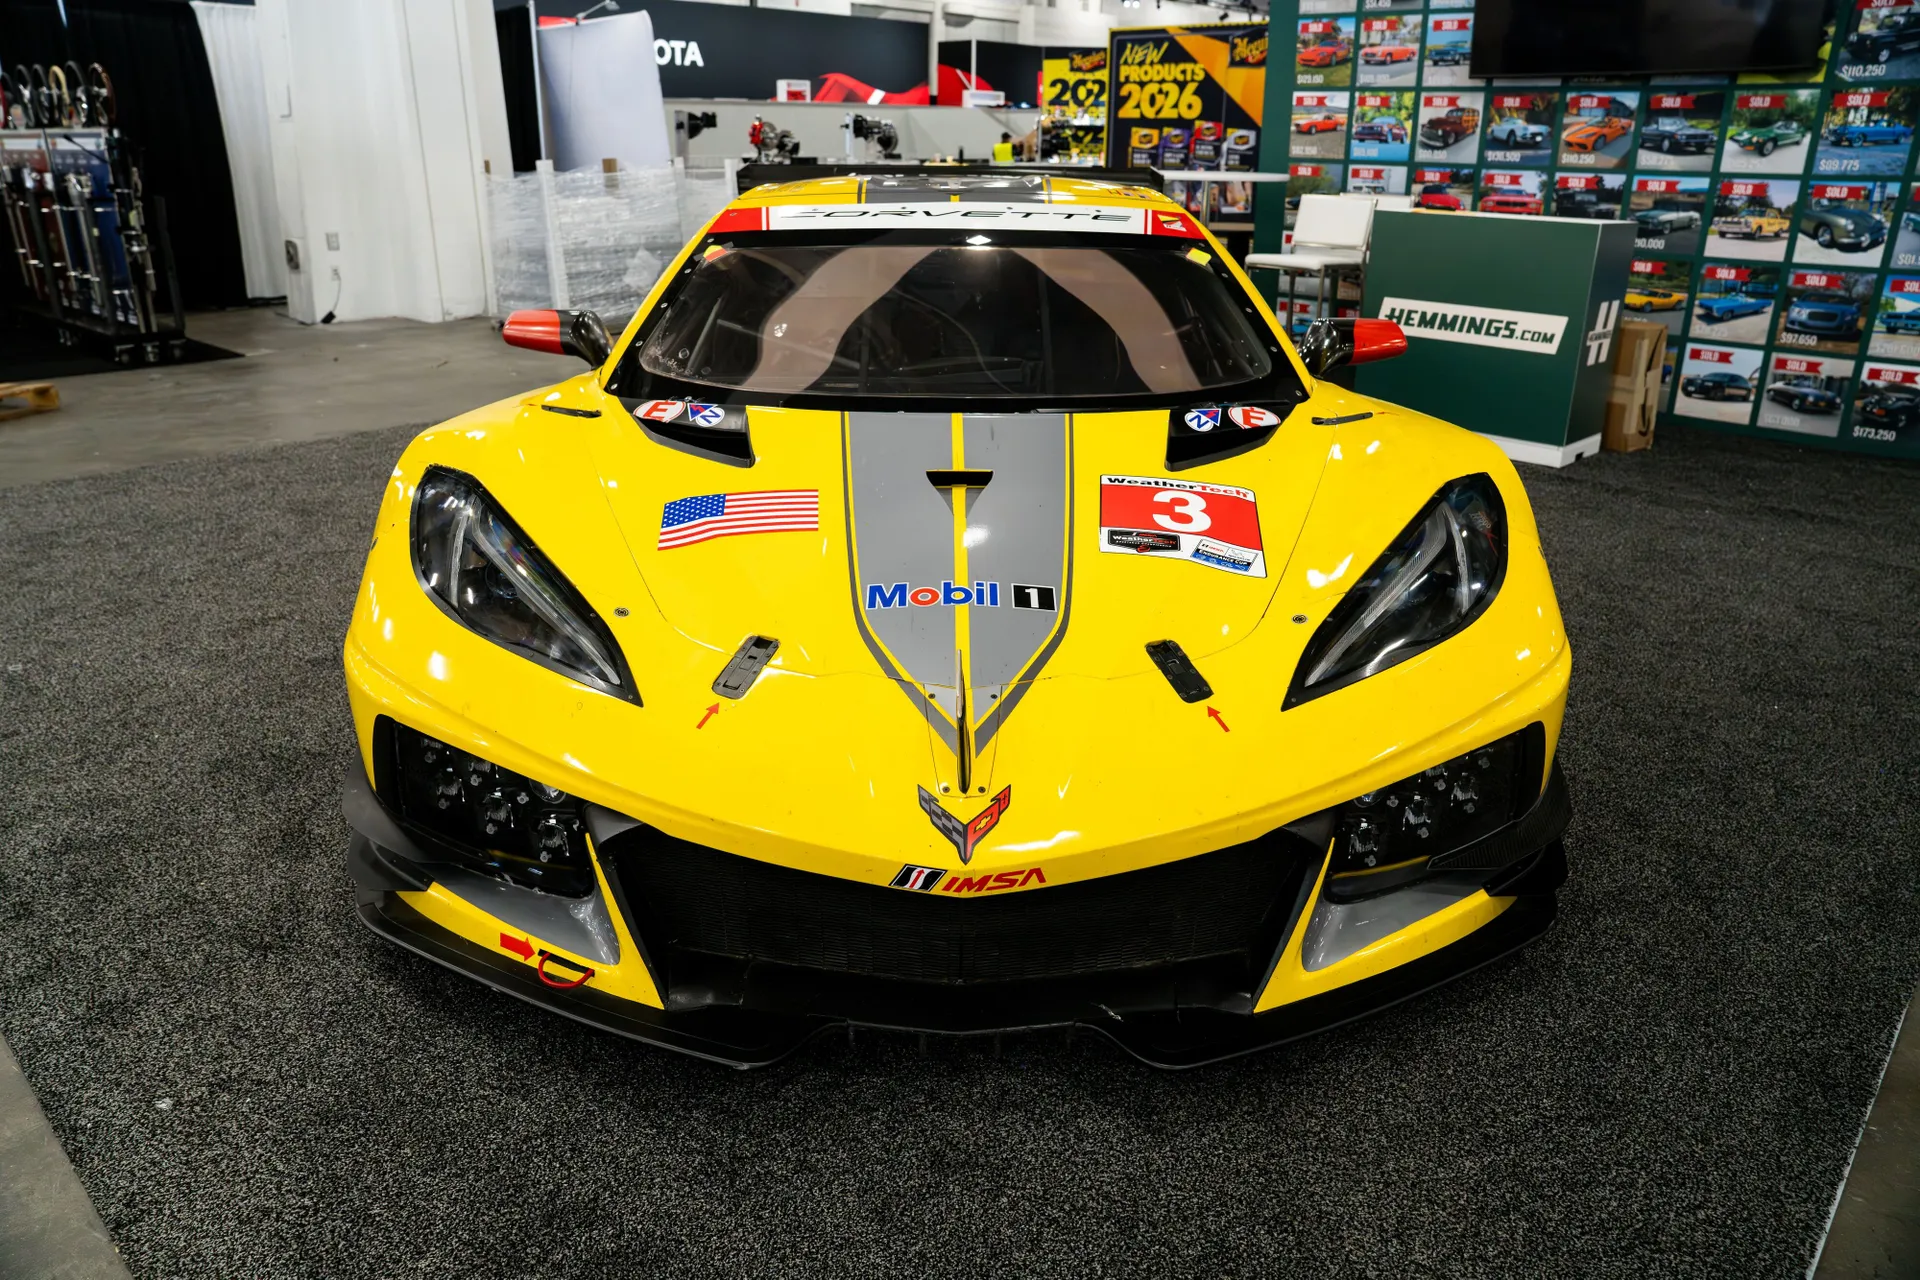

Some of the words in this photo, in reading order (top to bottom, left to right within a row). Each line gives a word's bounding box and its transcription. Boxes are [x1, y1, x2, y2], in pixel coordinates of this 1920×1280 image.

[654, 39, 704, 67] OTA
[1119, 41, 1169, 64] NEW
[1118, 63, 1206, 83] PRODUCTS
[1048, 78, 1106, 107] 202
[1117, 81, 1203, 120] 2026
[781, 209, 1132, 222] CORVETTE
[1903, 280, 1920, 293] SOL
[1384, 307, 1556, 345] HEMMINGS.COM
[1107, 477, 1249, 498] WeatherTech
[1152, 489, 1212, 533] 3
[866, 581, 1000, 610] Mobil
[942, 868, 1027, 893] IMSA
